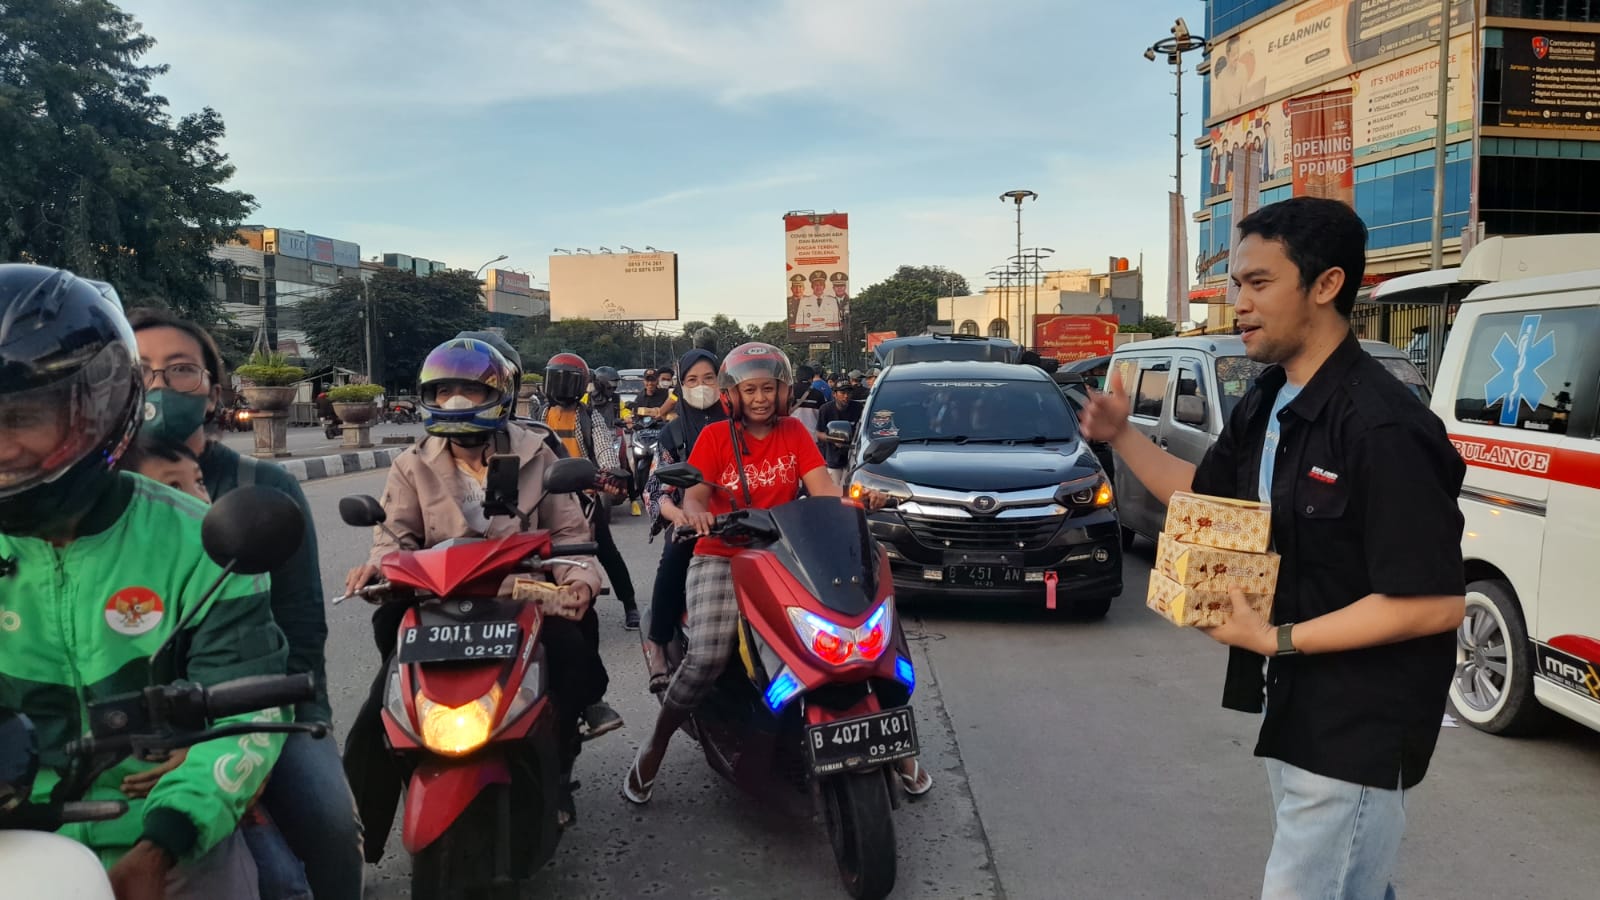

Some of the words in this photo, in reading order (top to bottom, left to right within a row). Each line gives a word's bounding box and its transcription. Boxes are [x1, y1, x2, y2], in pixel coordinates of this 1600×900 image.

[1267, 16, 1332, 53] E-LEARNING
[1385, 71, 1404, 82] YOUR
[1405, 62, 1429, 76] RIGHT
[1373, 85, 1420, 103] COMMUNICATION
[1374, 103, 1390, 113] VISUAL
[1390, 91, 1434, 108] COMMUNICATION
[1372, 110, 1407, 124] MANAGEMENT
[1372, 123, 1394, 133] TOURISM
[1372, 131, 1396, 142] BUSINESS
[1396, 124, 1421, 137] SERVICES
[1293, 136, 1351, 158] OPENING
[968, 567, 991, 580] 451
[1004, 568, 1020, 581] AN
[406, 628, 417, 643] B
[428, 625, 472, 643] 3011
[482, 623, 518, 639] UNF
[813, 731, 824, 749] B
[831, 721, 869, 745] 4077
[821, 762, 843, 772] YAMAHA
